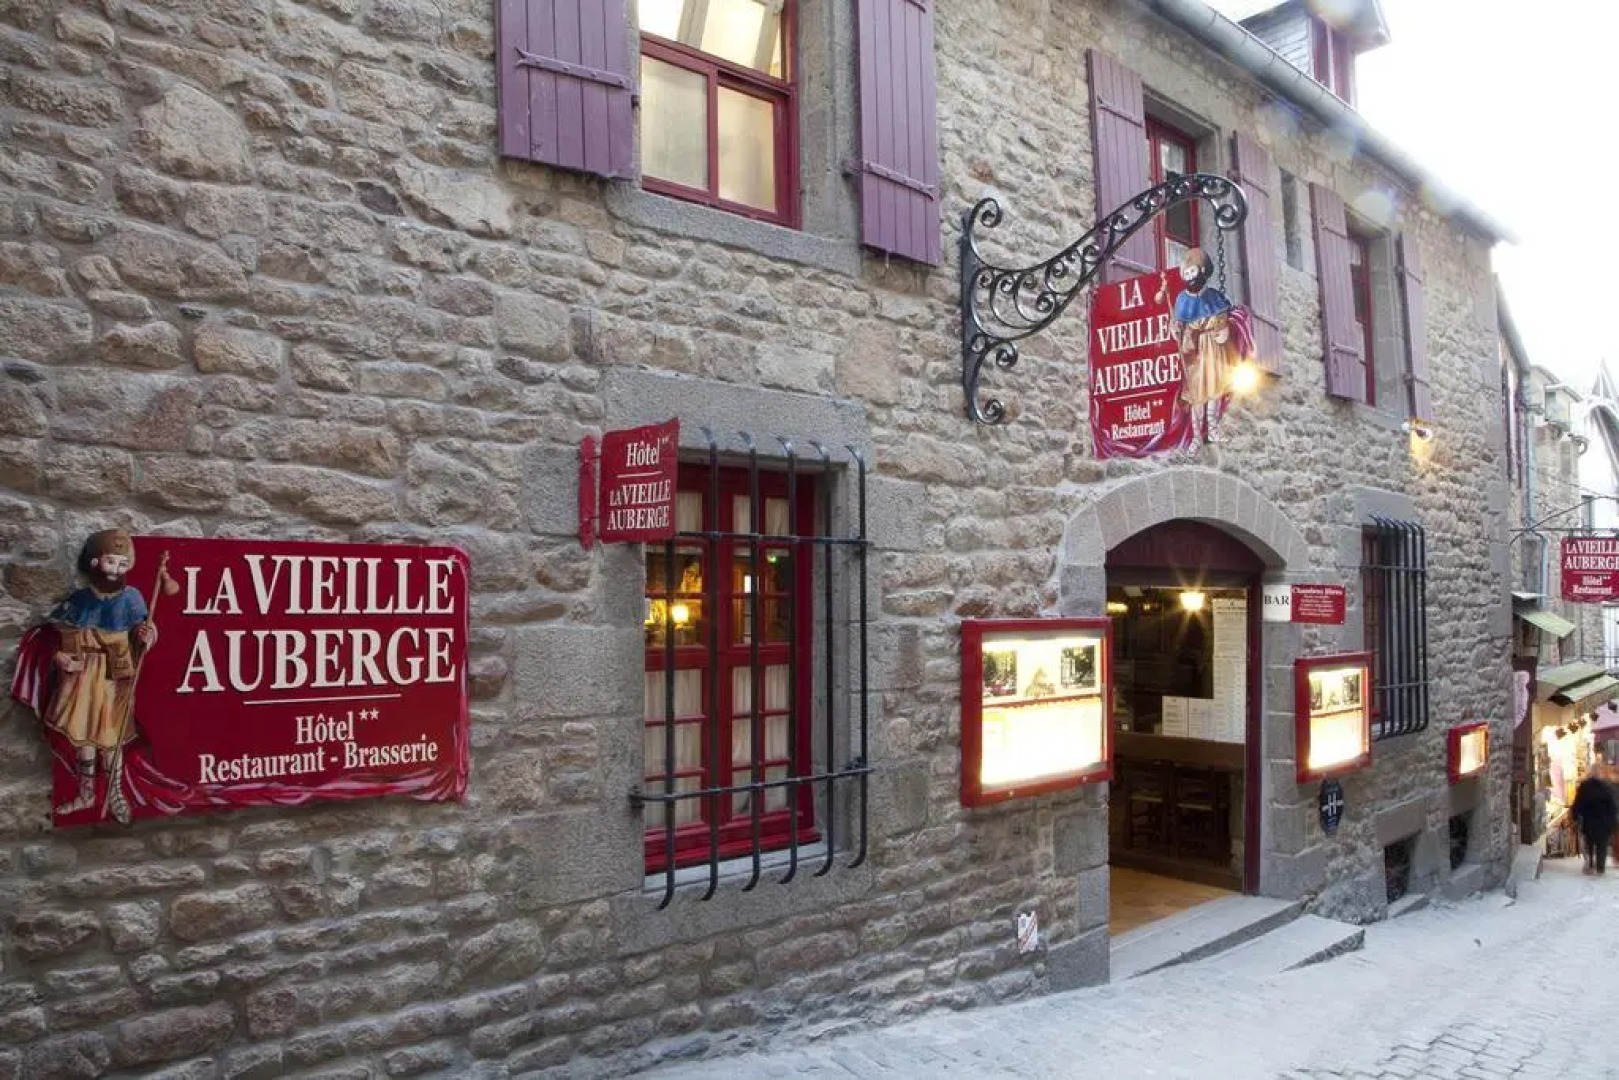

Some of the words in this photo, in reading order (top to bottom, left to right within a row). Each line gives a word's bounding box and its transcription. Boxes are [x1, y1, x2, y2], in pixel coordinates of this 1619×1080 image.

[1119, 280, 1144, 311] LA
[1097, 313, 1171, 355] VIEILLE
[1093, 353, 1182, 396] AUBERGE
[1123, 402, 1151, 422] Hôtel
[1111, 419, 1165, 440] Restaurant
[626, 437, 660, 468] Hôtel
[609, 489, 622, 507] LA
[622, 479, 671, 505] VIEILLE
[606, 505, 670, 531] AUBERGE
[1566, 544, 1578, 554] LA
[182, 566, 240, 615] LA
[244, 554, 455, 615] VIEILLE
[1264, 595, 1289, 605] BAR
[176, 627, 456, 694] AUBERGE
[295, 712, 354, 745] Hôtel
[199, 748, 326, 784] Restaurant
[344, 733, 438, 769] Brasserie
